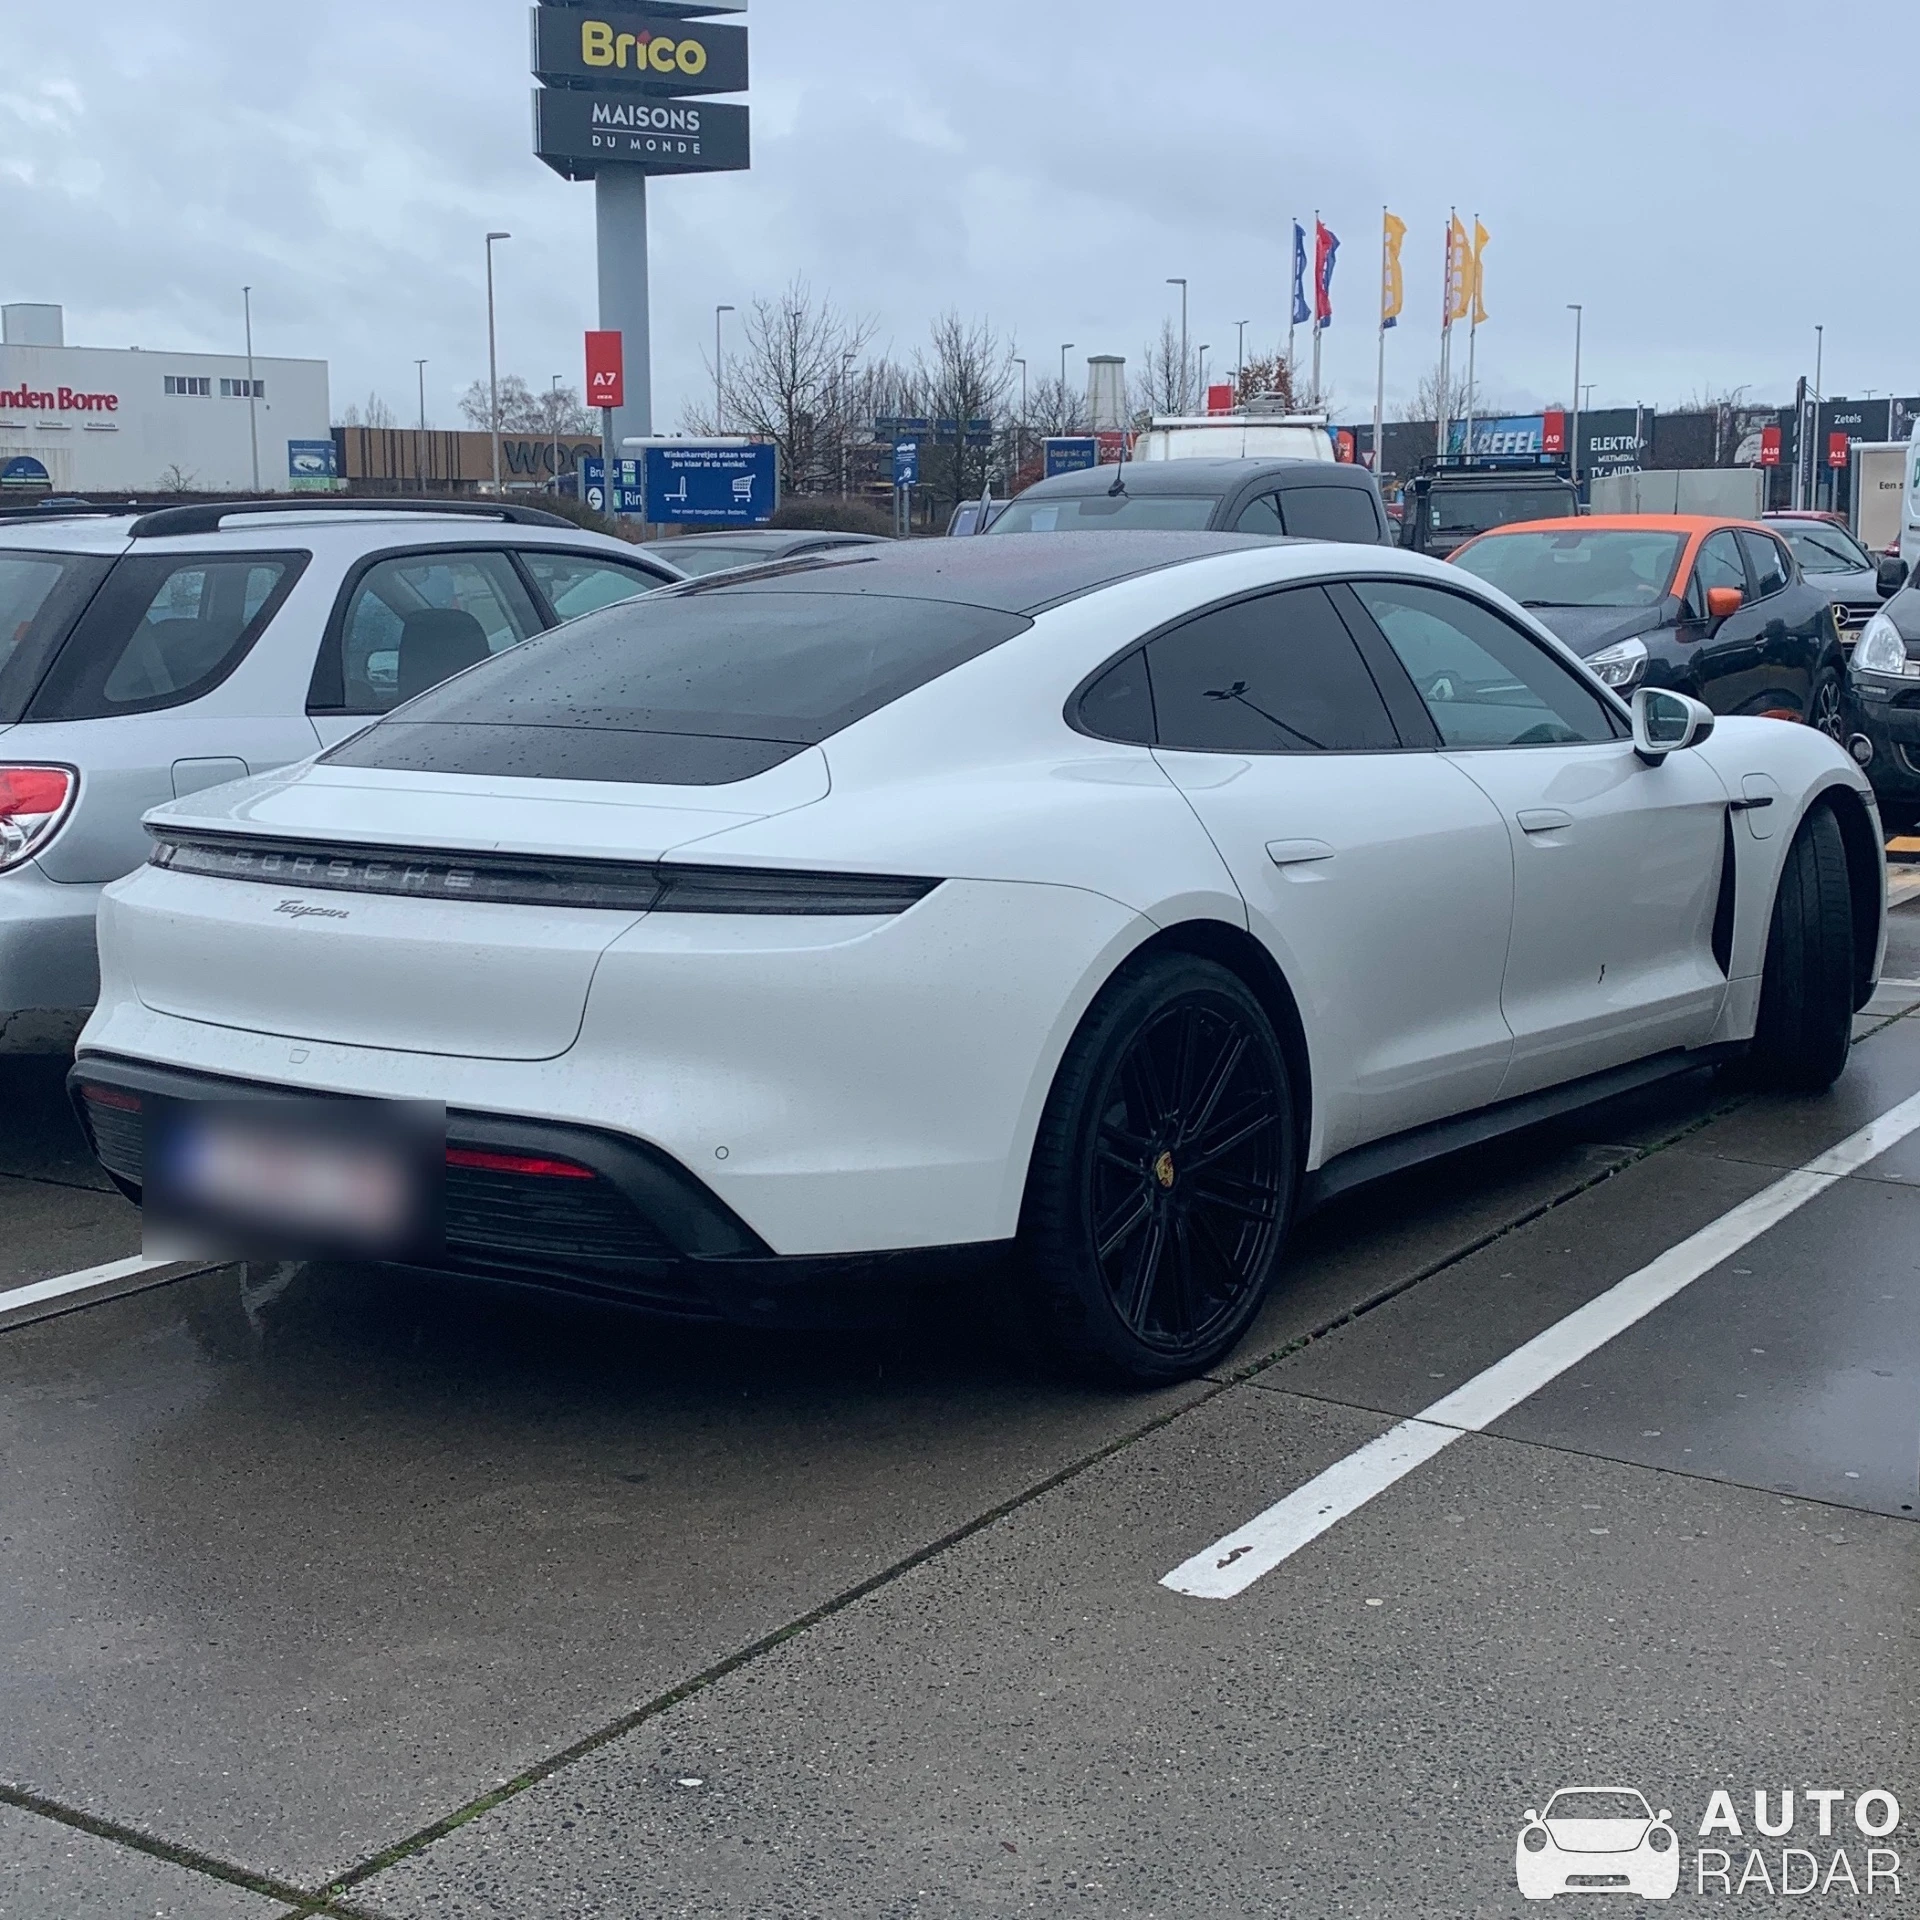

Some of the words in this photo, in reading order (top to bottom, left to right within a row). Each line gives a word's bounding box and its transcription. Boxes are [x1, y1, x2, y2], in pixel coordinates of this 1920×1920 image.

[581, 20, 707, 75] Brico
[591, 102, 700, 131] MAISONS
[592, 134, 616, 148] DU
[630, 139, 701, 155] MONDE
[593, 372, 616, 386] A7
[57, 387, 119, 411] Borre
[1834, 413, 1862, 424] Zetels
[1545, 435, 1560, 444] A9
[663, 450, 718, 460] Winkelkarretjes
[719, 451, 739, 459] staan
[1762, 447, 1780, 455] A10
[671, 460, 683, 469] jou
[684, 460, 702, 468] klaar
[703, 460, 711, 468] in
[590, 466, 620, 478] Bruel
[1590, 466, 1604, 478] TV
[1879, 482, 1897, 490] Een
[233, 851, 476, 888] PORSCHE
[272, 900, 350, 919] Taycan
